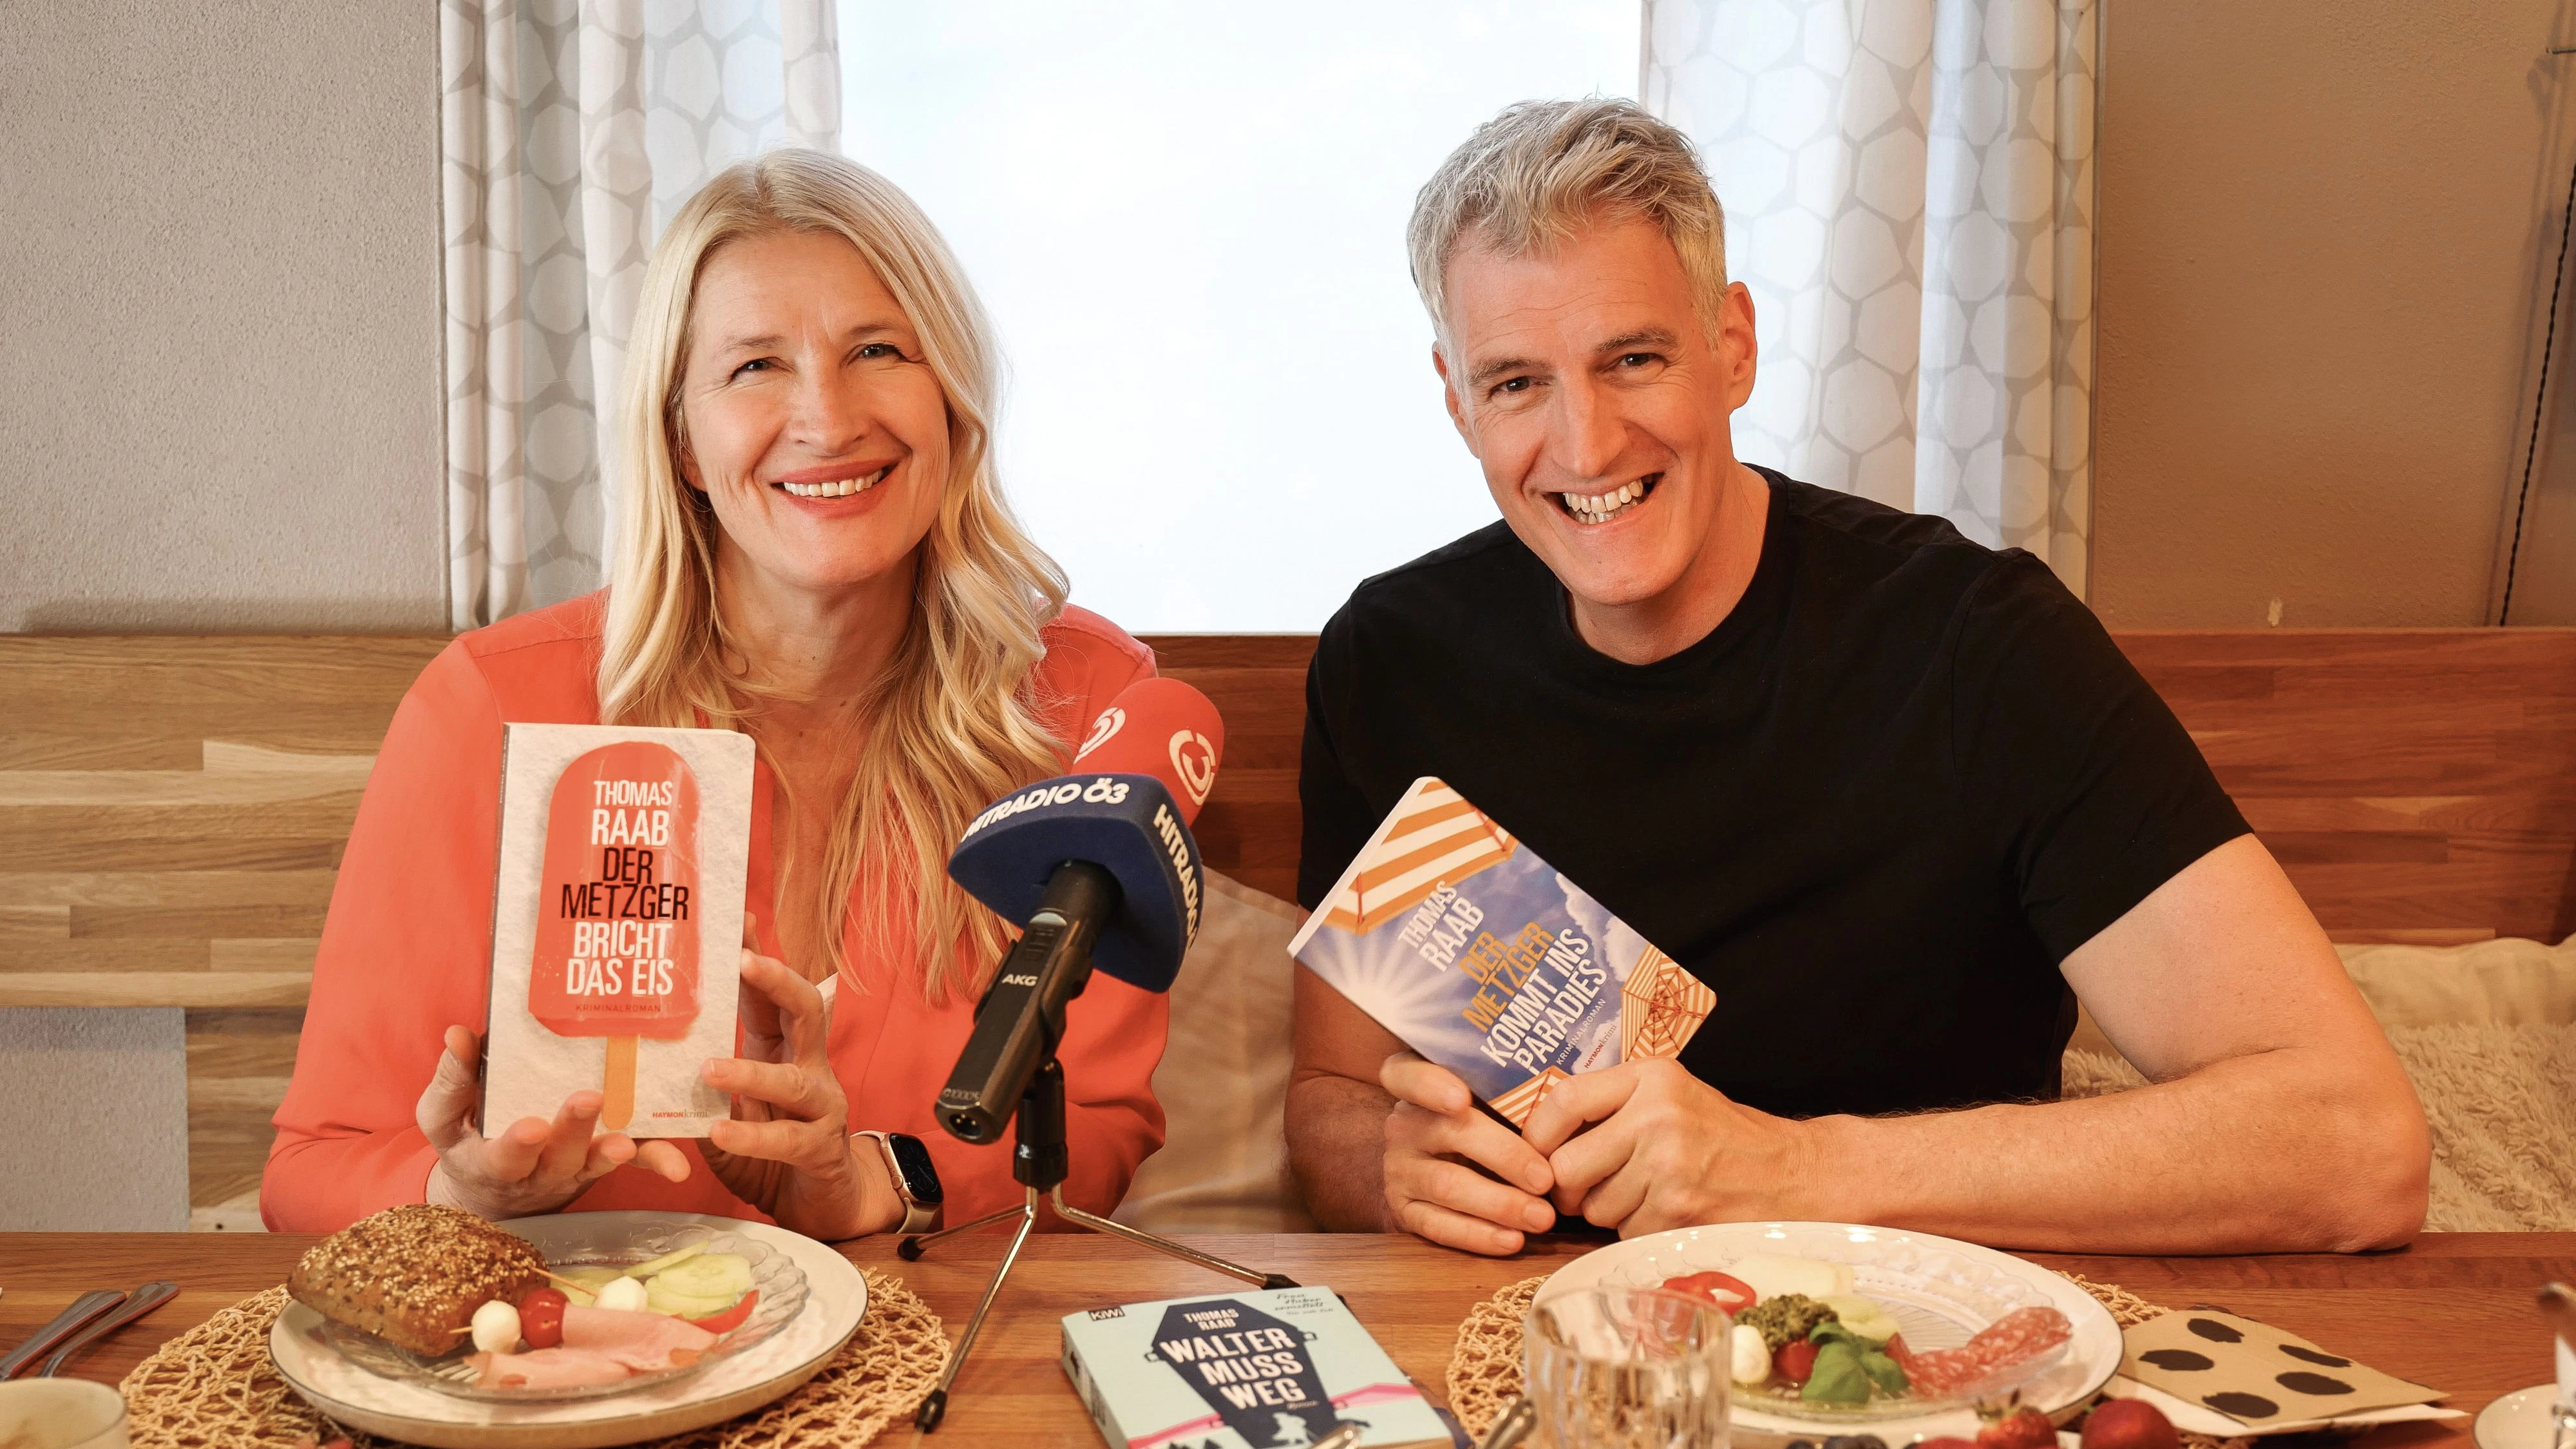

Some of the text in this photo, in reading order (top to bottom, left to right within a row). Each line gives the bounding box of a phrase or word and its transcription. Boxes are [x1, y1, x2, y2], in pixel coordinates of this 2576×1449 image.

[593, 780, 673, 806] THOMAS
[960, 777, 1130, 843] HITRADIO Ö3
[591, 808, 670, 846] RAAB
[603, 847, 654, 884] DER
[561, 882, 689, 920] METZGER
[1398, 880, 1458, 949] THOMAS
[573, 920, 673, 959] BRICHT
[1418, 897, 1484, 972] RAAB
[566, 958, 674, 996] DAS EIS
[1458, 931, 1510, 986] DER
[1461, 921, 1555, 1034] METZGER
[1001, 974, 1038, 987] AKG
[1480, 928, 1589, 1068] KOMMT INS
[576, 1004, 661, 1013] KRIMINALROMAN
[1513, 958, 1607, 1076] PARADIES
[1556, 998, 1606, 1065] KRIMINALROMAN
[1184, 1308, 1239, 1323] THOMAS
[1198, 1318, 1236, 1331] RAAB
[1159, 1327, 1297, 1363] WALTER
[1198, 1351, 1304, 1385] MUSS
[1219, 1378, 1307, 1410] WEG
